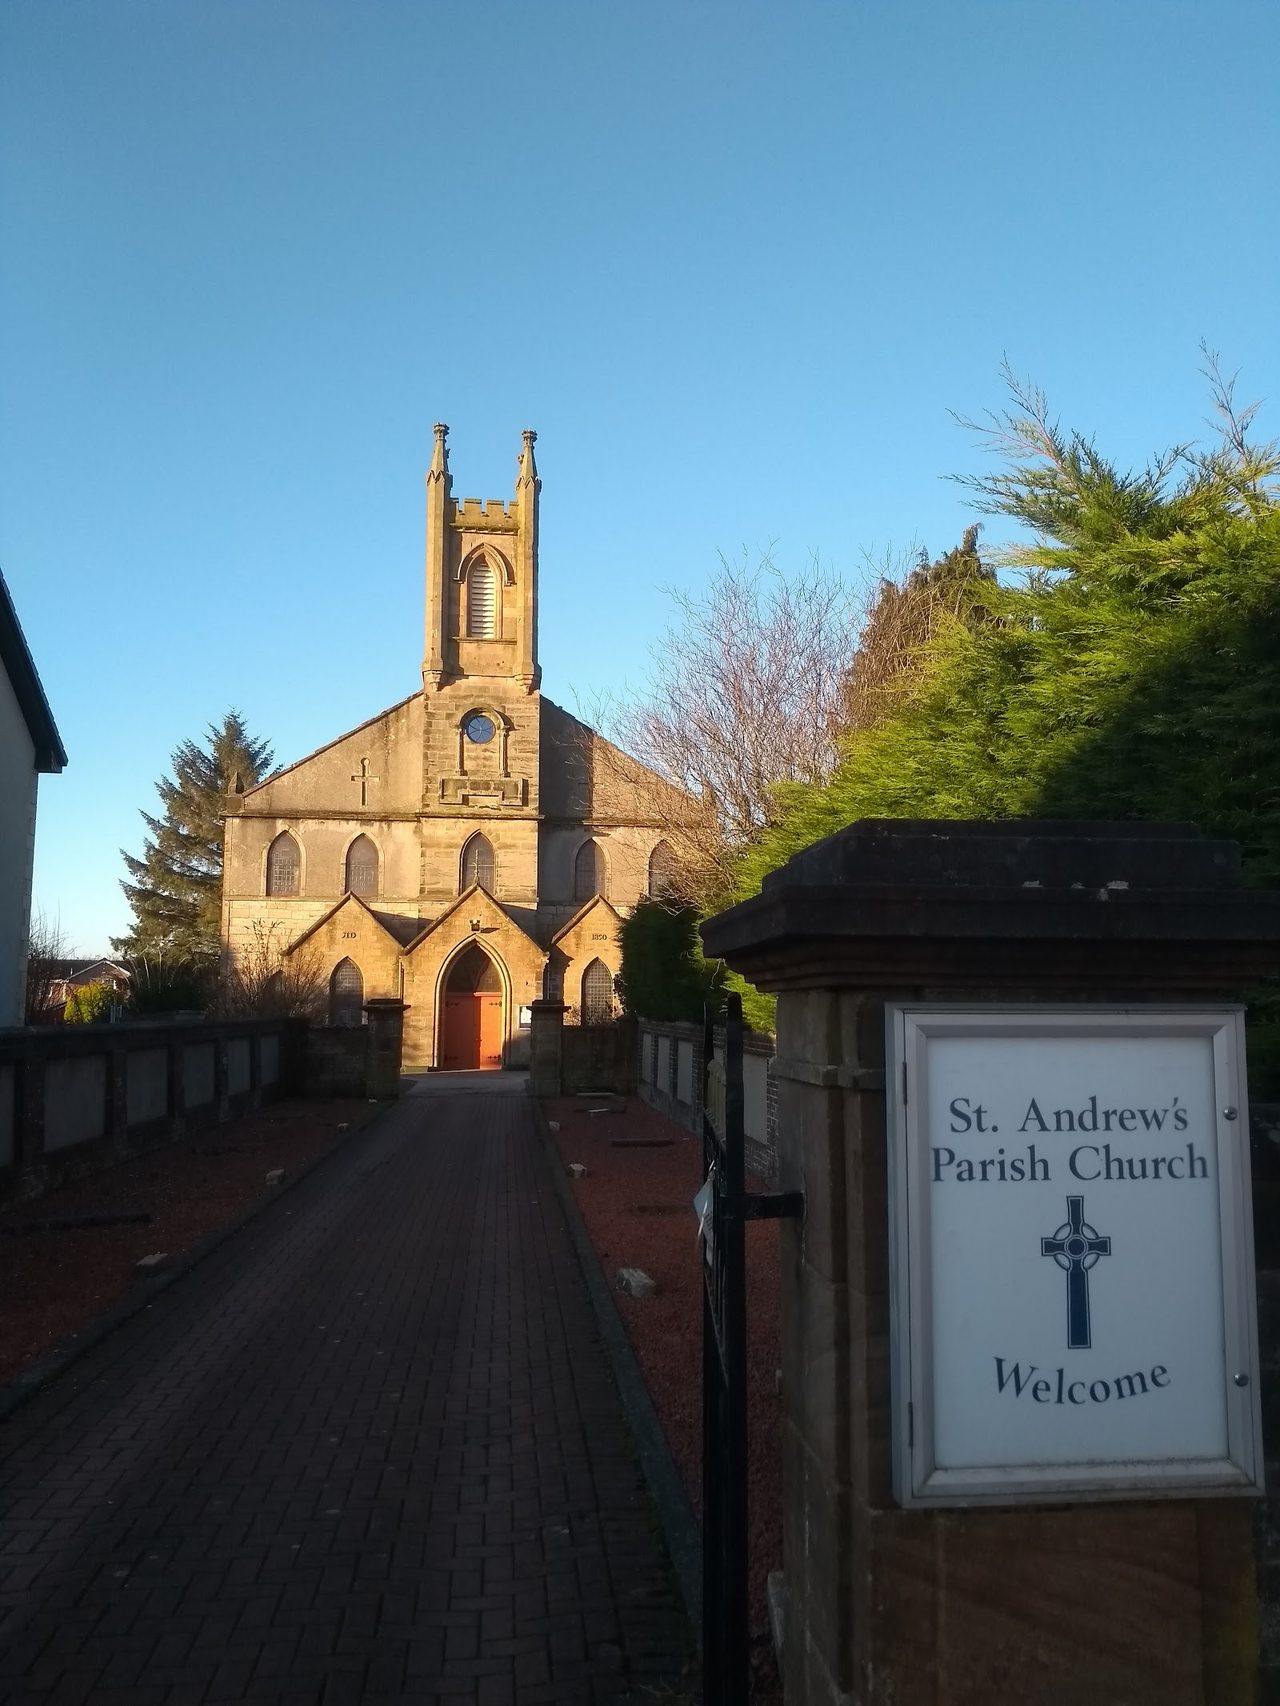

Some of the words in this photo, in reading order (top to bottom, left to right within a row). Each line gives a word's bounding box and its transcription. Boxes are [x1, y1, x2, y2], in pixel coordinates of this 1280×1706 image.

[950, 1097, 999, 1133] St.
[1017, 1095, 1189, 1133] Andrew's
[931, 1144, 1051, 1183] Parish
[1068, 1143, 1209, 1181] Church
[993, 1356, 1171, 1405] Welcome
